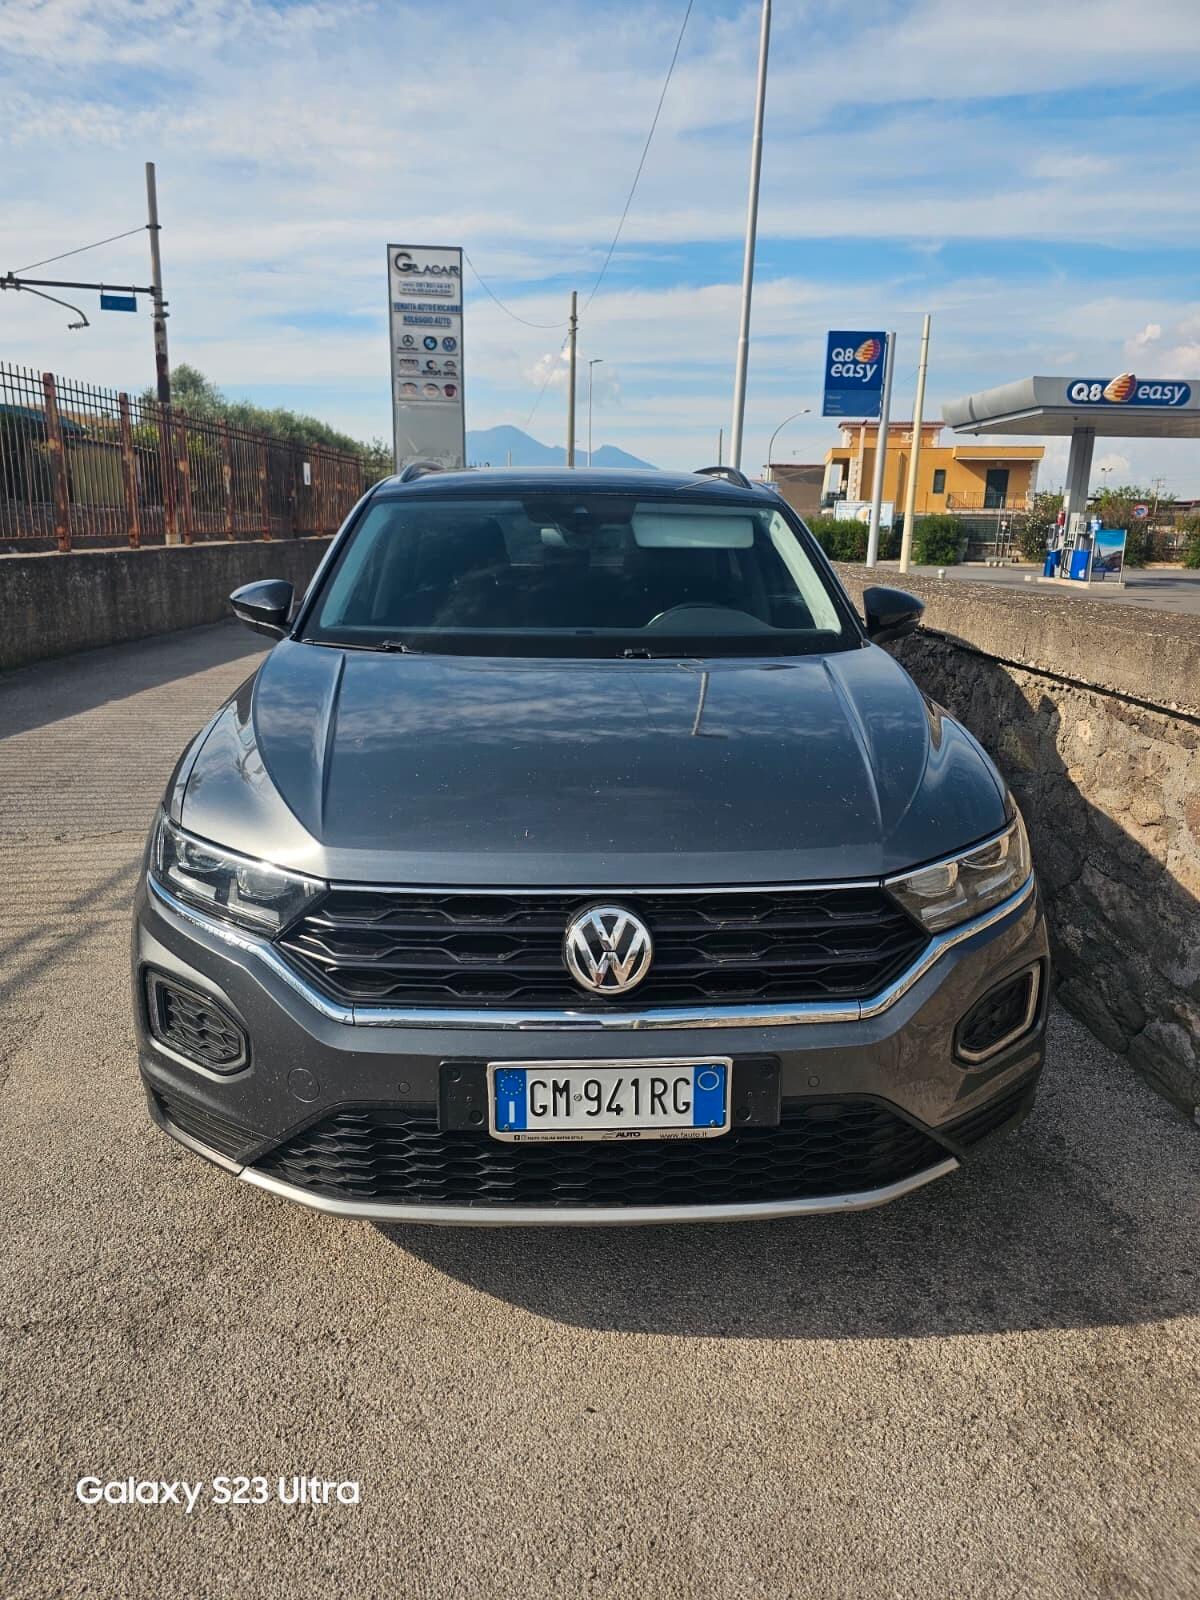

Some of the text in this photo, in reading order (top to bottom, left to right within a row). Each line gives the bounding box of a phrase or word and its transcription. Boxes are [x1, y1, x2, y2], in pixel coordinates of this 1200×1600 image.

[831, 347, 854, 362] Q8
[830, 363, 878, 383] easy
[1071, 382, 1186, 405] Q8 easy
